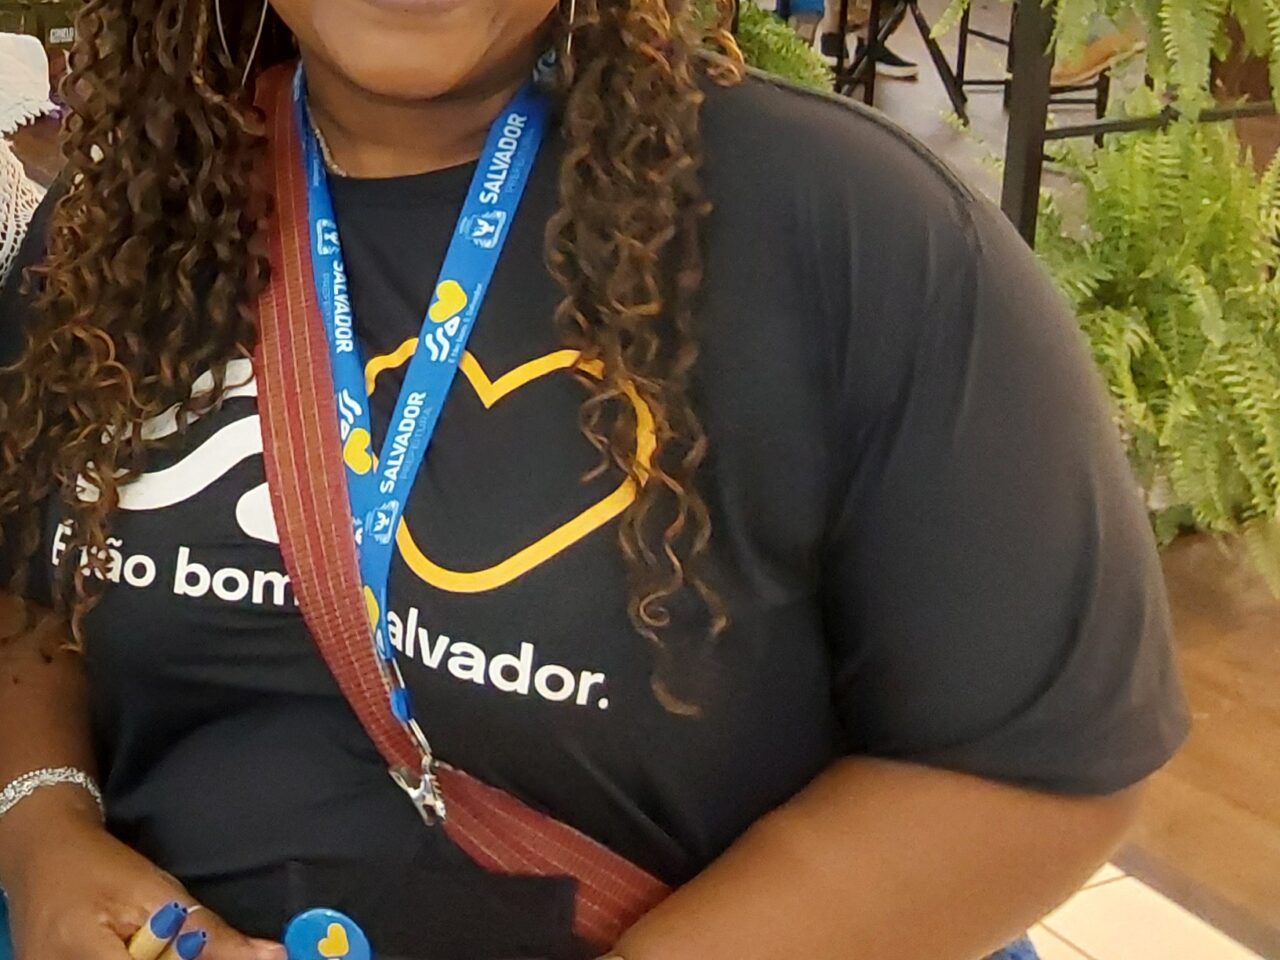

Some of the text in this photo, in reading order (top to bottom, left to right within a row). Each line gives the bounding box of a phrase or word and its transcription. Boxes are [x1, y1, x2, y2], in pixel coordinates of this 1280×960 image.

[479, 113, 527, 205] SALVADOR
[333, 259, 353, 354] SALVADOR
[379, 392, 427, 494] SALVADOR
[173, 546, 301, 606] bom
[387, 607, 609, 709] alvador.
